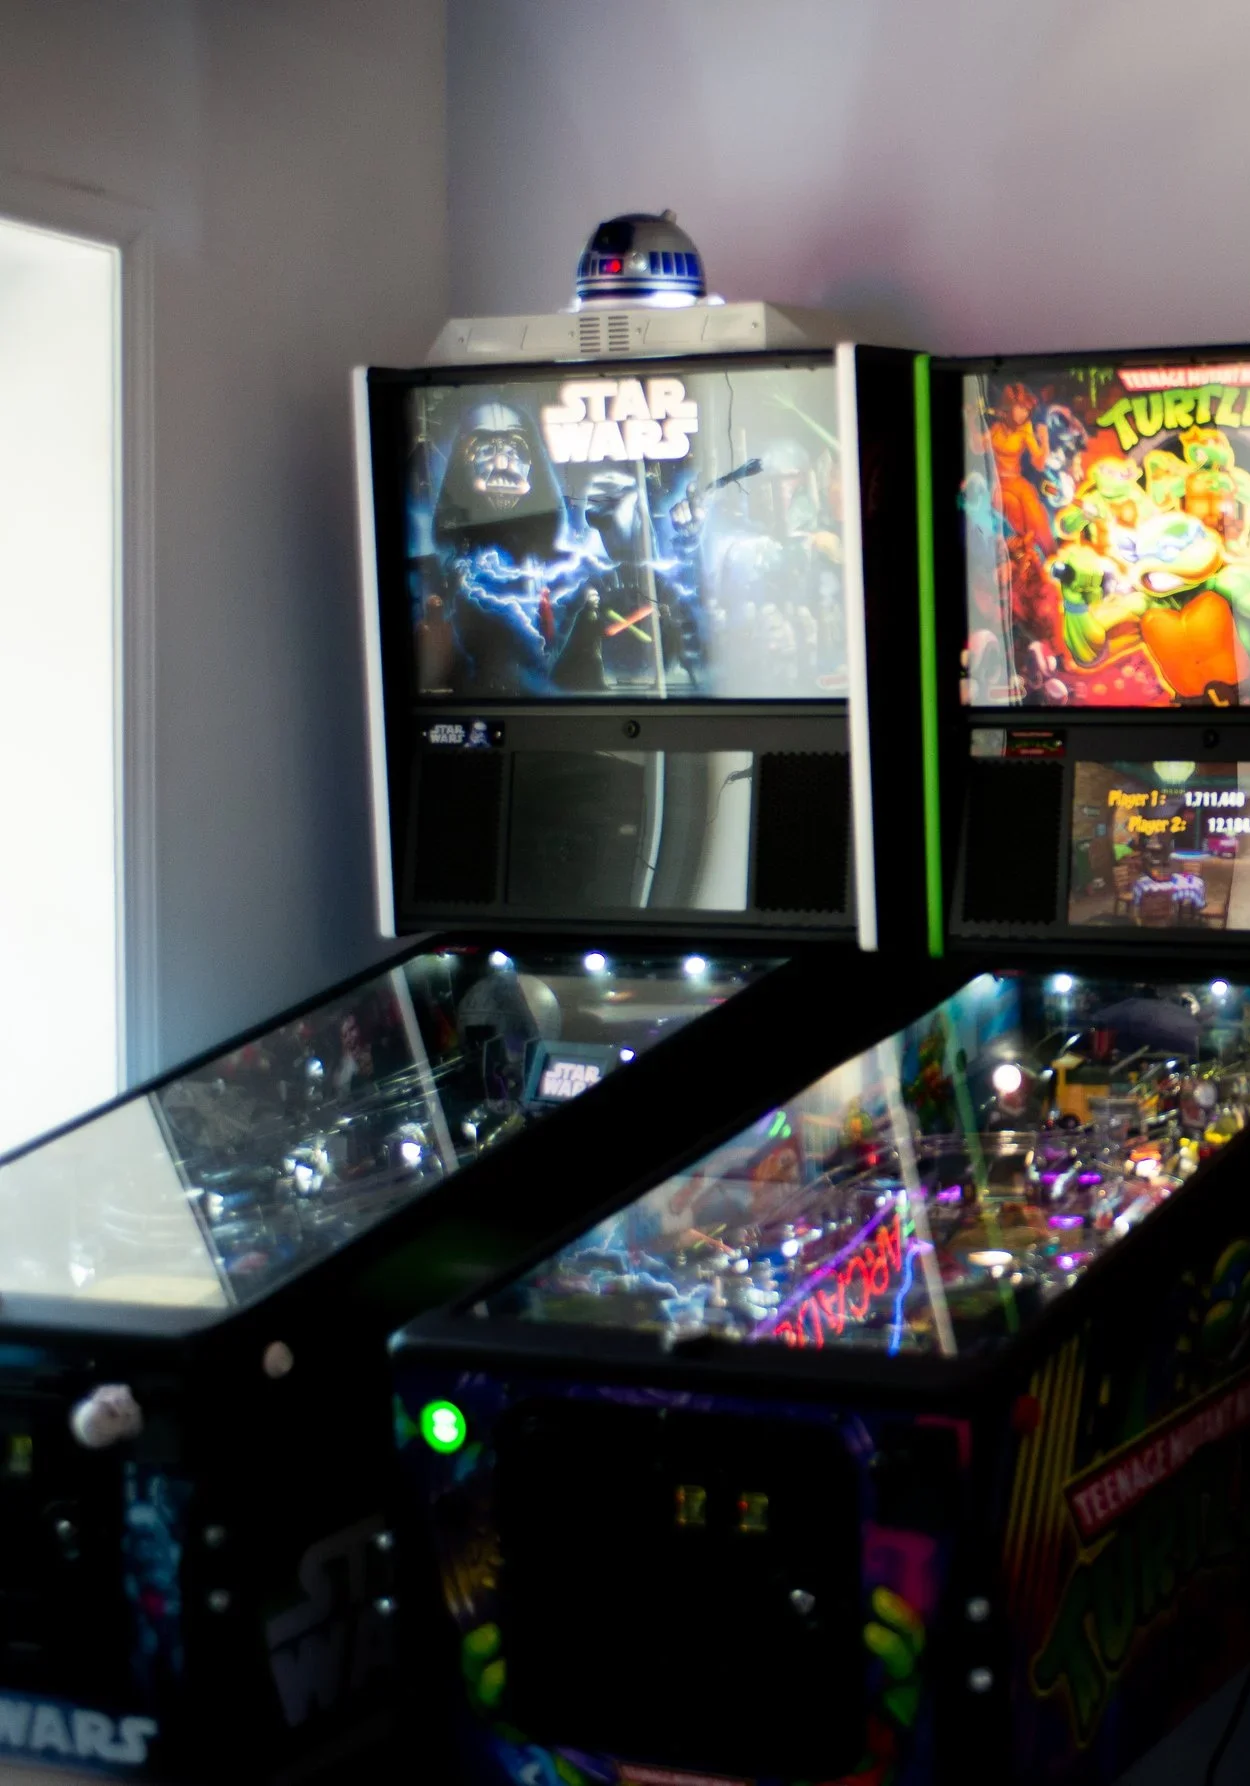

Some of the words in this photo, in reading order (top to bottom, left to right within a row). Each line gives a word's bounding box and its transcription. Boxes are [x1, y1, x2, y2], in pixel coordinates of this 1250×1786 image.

[540, 377, 697, 422] STAR
[543, 418, 698, 463] WARS
[429, 723, 465, 735] STAR
[430, 732, 465, 744] WARS
[1108, 790, 1149, 809] Player
[1127, 815, 1169, 836] Player
[544, 1062, 603, 1084] STAR
[541, 1078, 590, 1098] WAR
